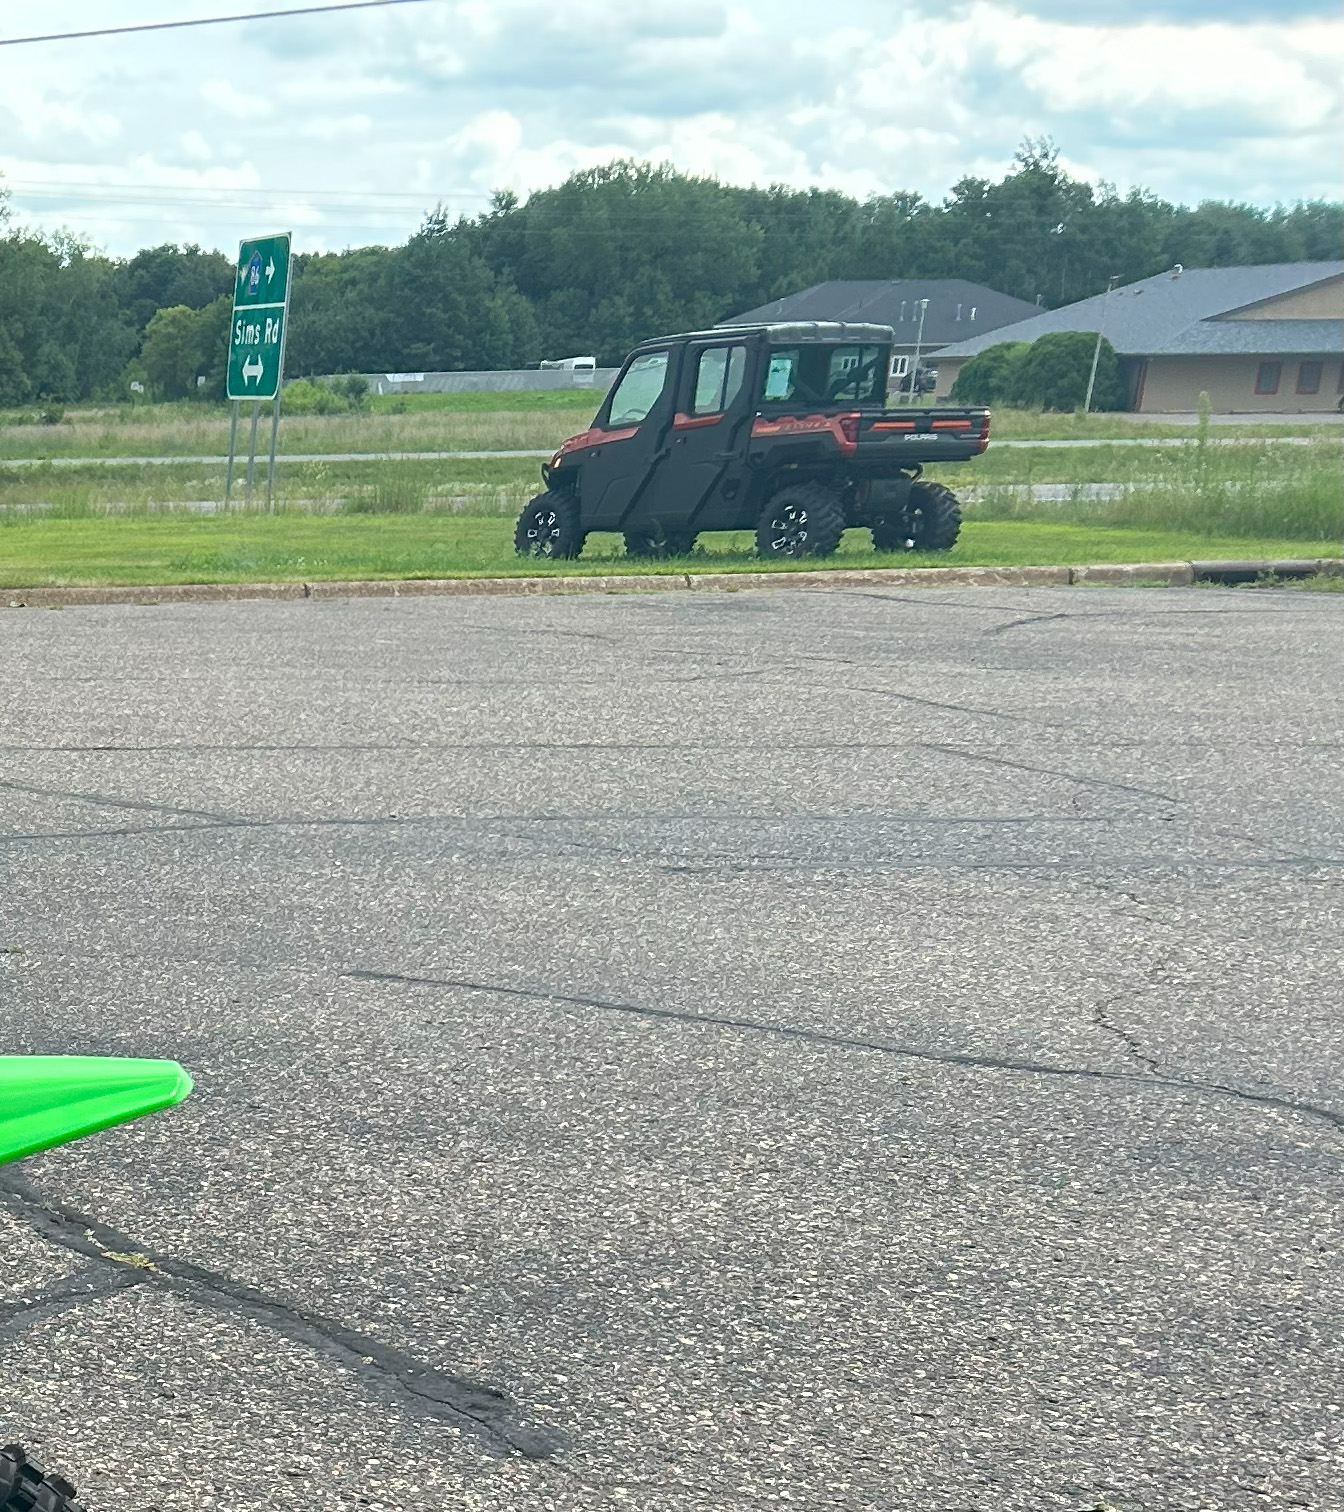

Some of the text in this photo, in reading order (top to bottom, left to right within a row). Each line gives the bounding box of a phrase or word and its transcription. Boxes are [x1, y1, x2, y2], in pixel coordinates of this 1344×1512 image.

[235, 317, 280, 345] Sims Rd
[904, 433, 938, 441] POLARIS
